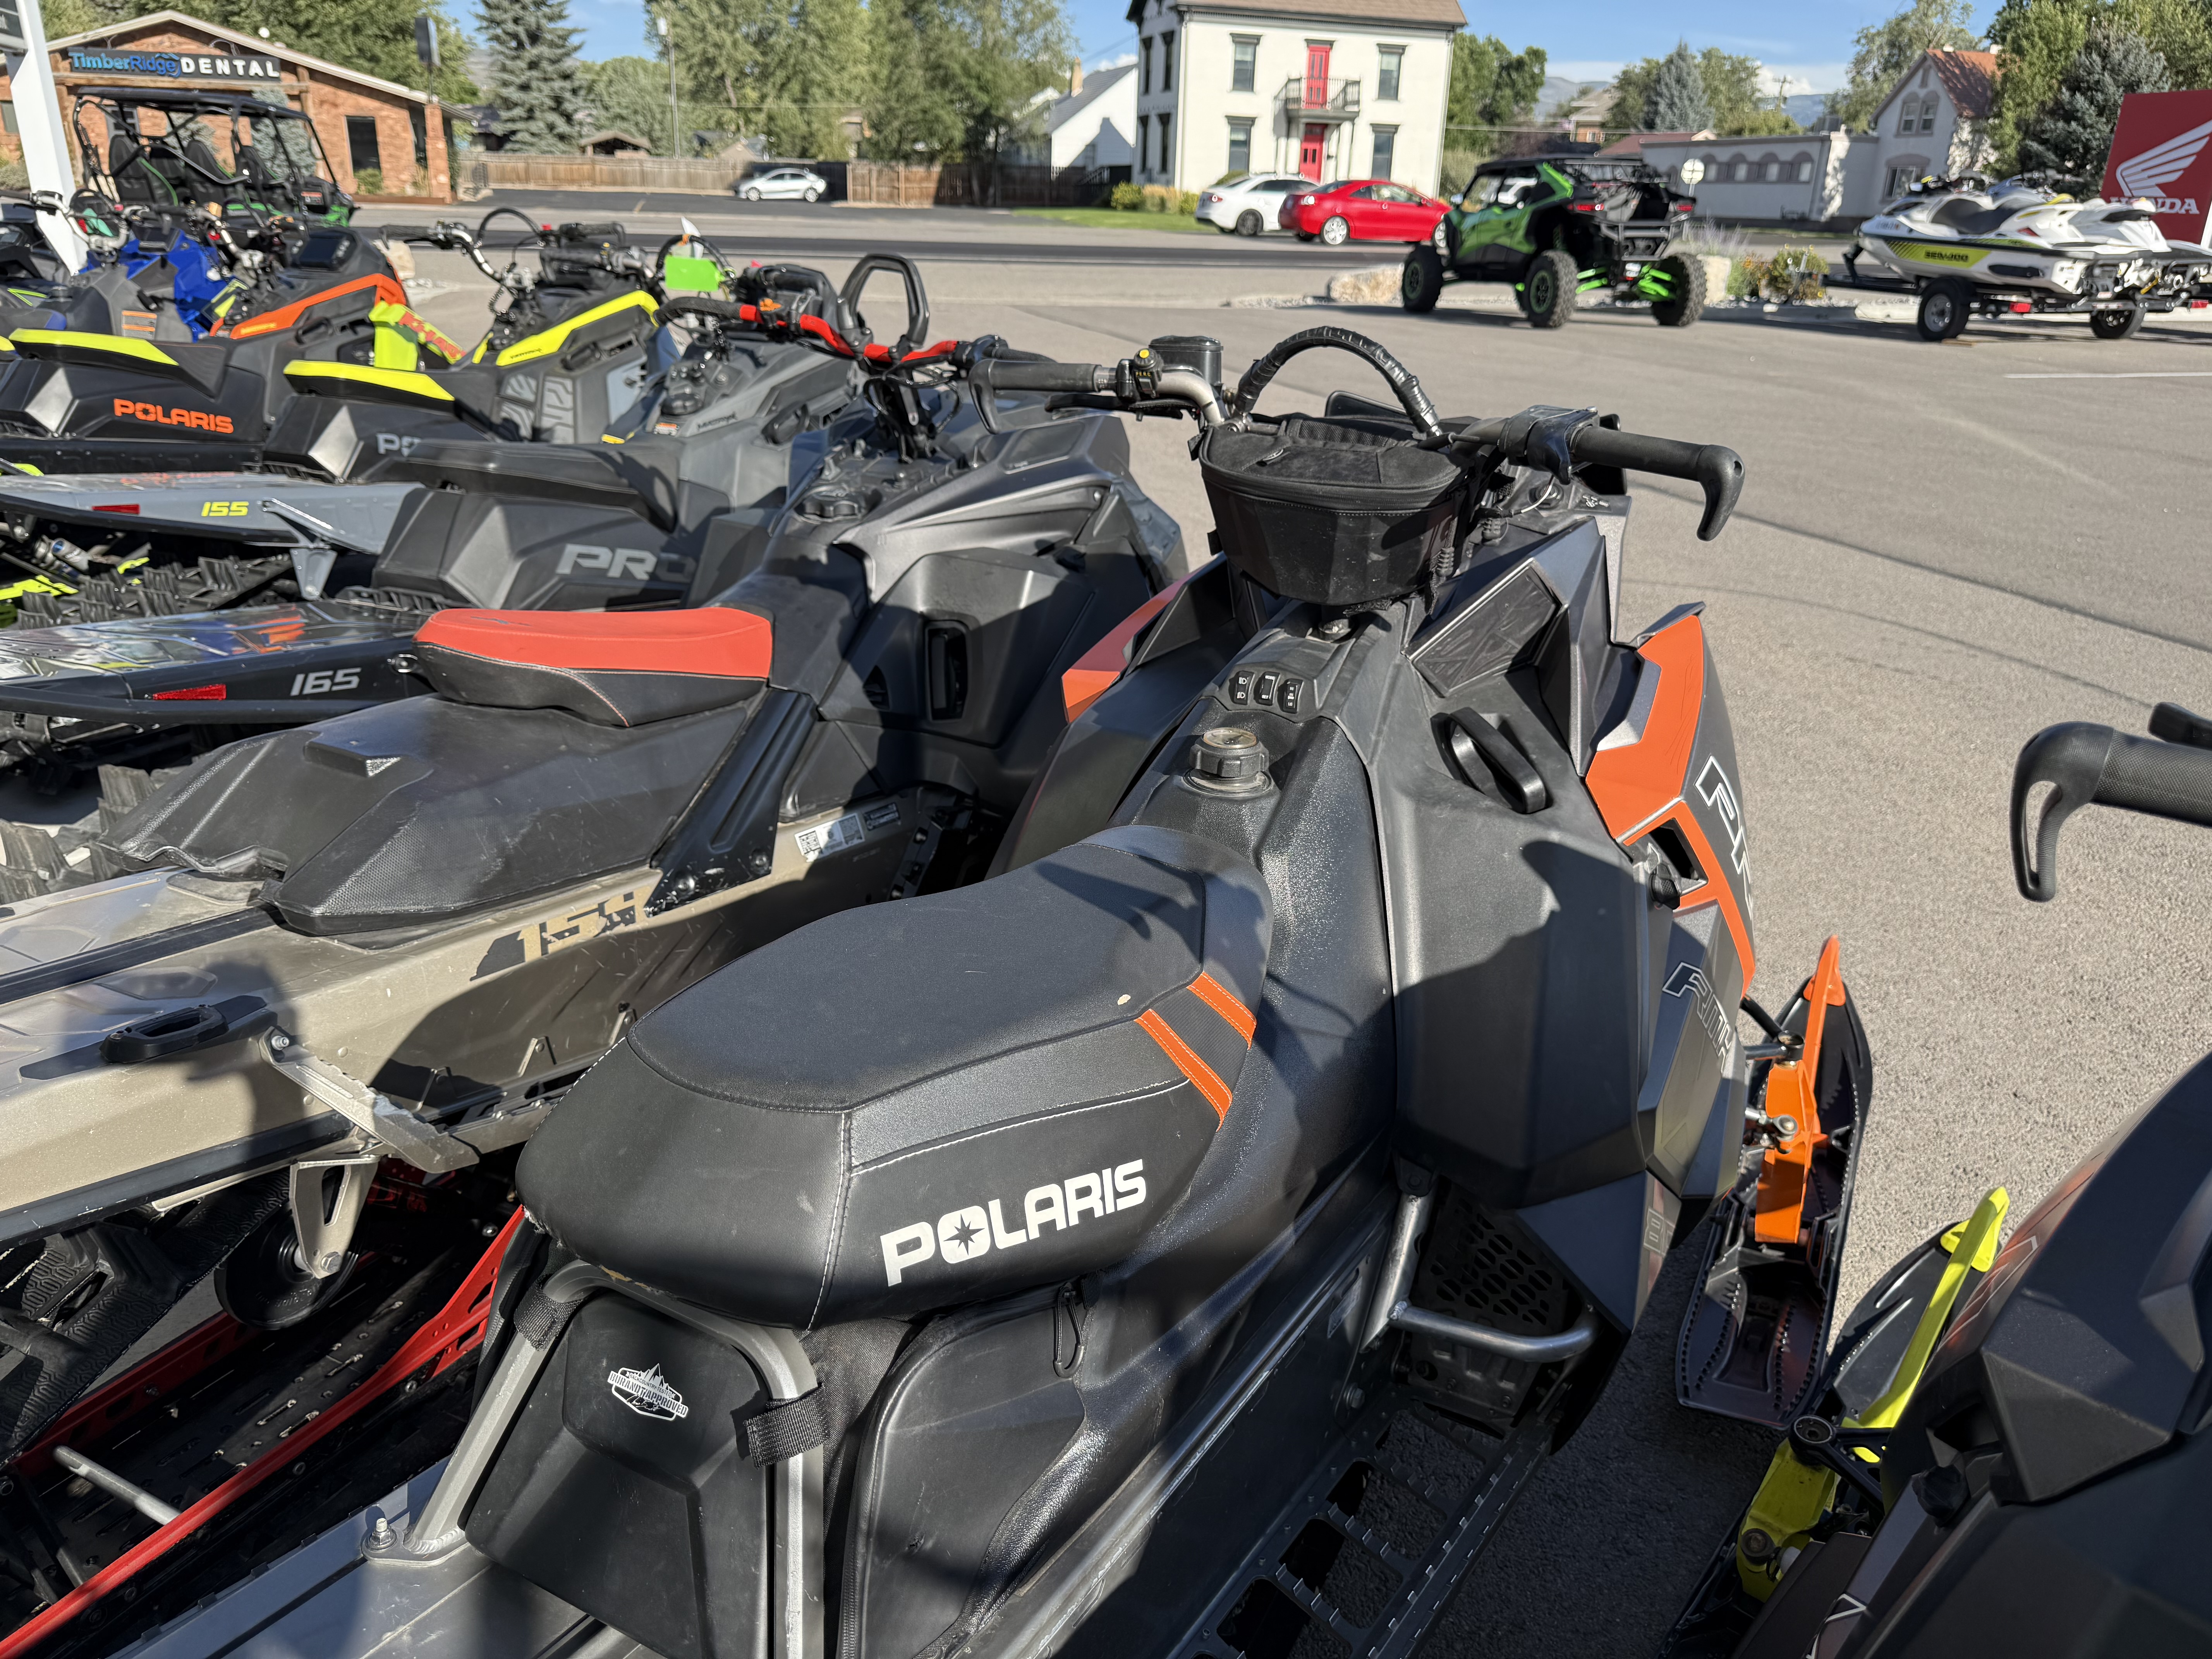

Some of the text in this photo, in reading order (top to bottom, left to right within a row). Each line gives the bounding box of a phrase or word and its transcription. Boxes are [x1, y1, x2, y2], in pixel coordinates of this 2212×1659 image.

[69, 52, 280, 77] TimberRidge DENTAL
[113, 398, 234, 433] POLARIS
[201, 501, 249, 517] 155
[290, 667, 362, 696] 165
[880, 1159, 1147, 1286] POLARIS
[643, 1389, 688, 1415] APPROVED
